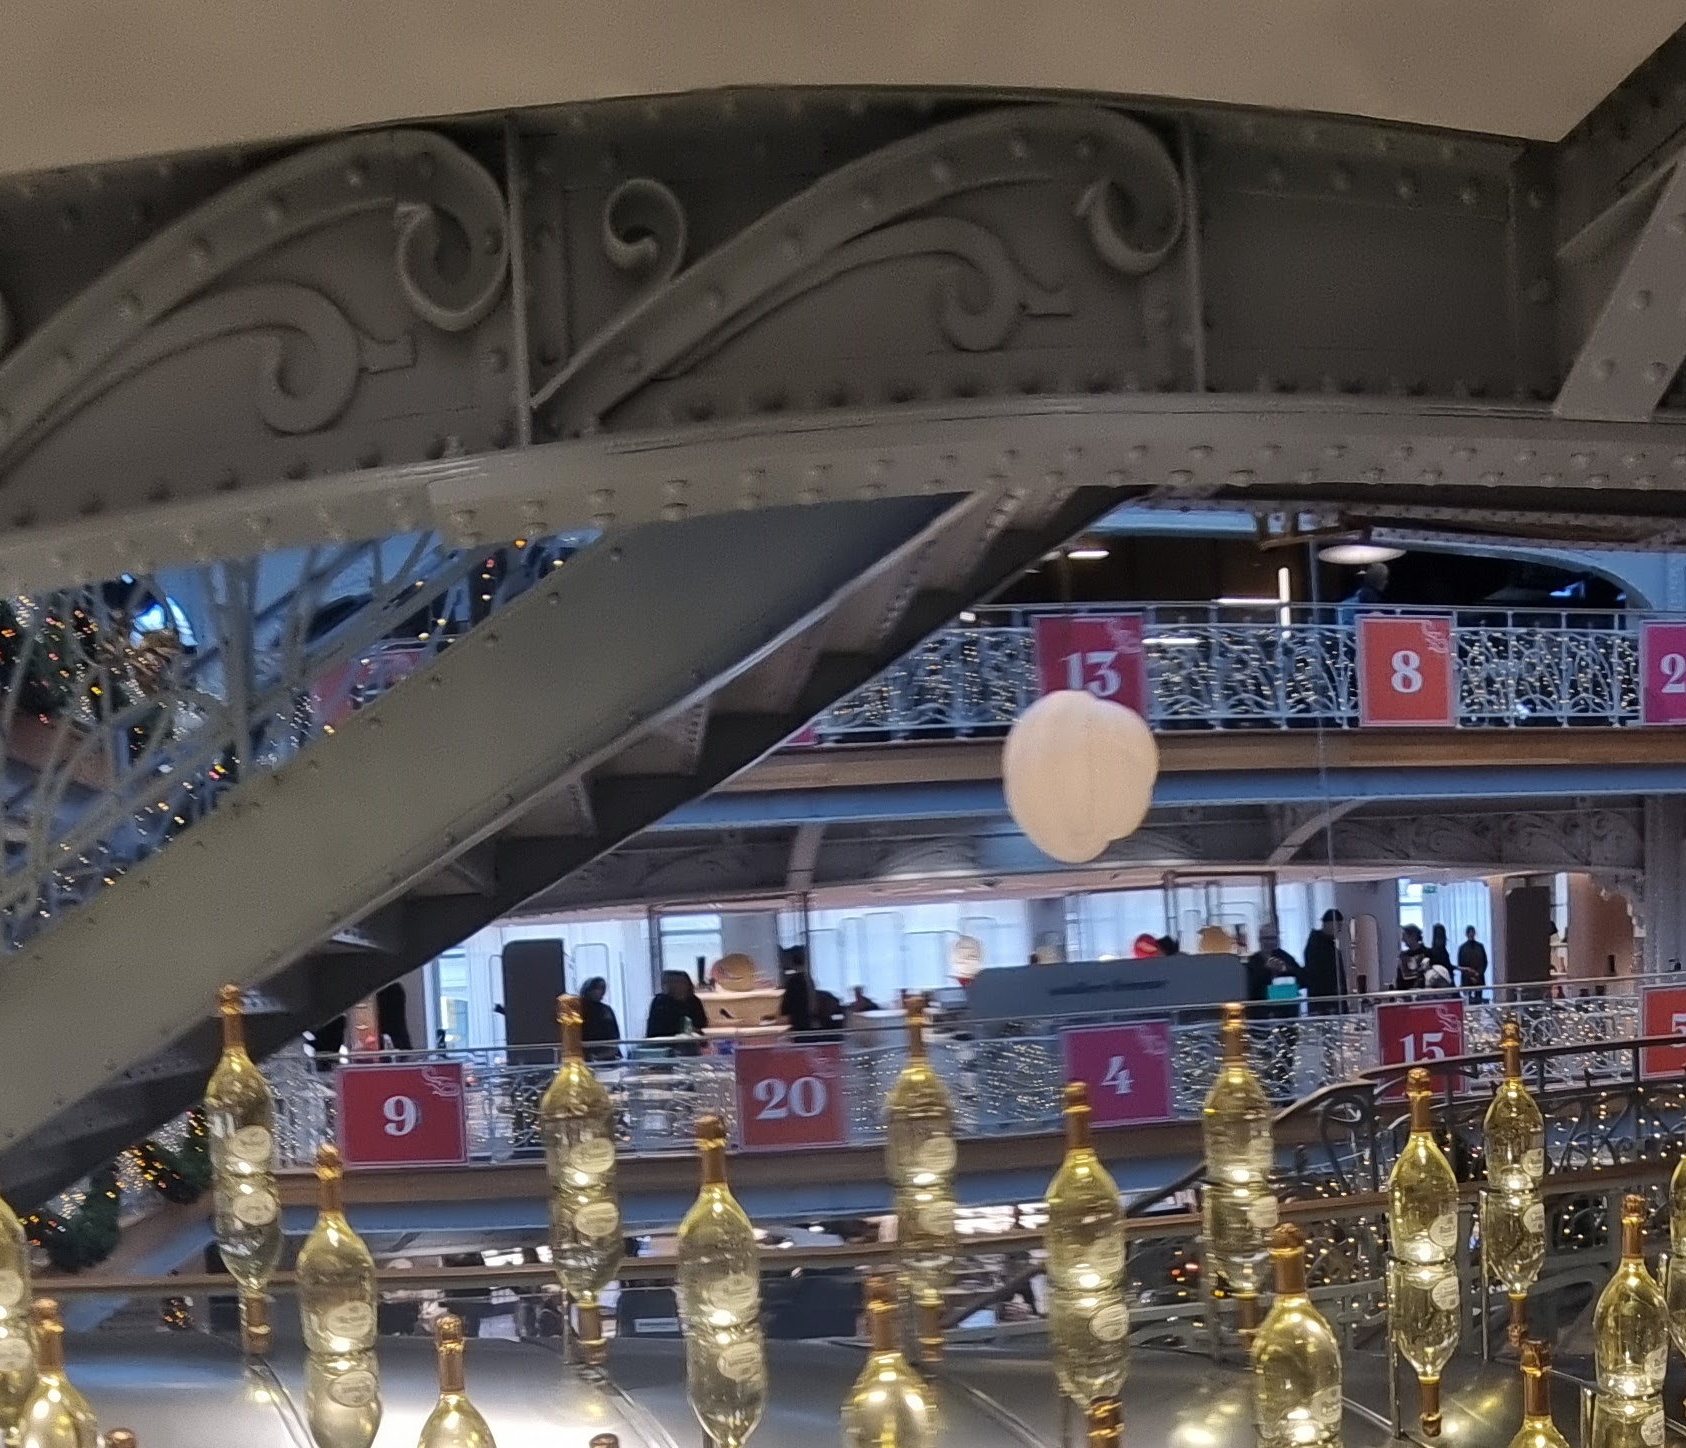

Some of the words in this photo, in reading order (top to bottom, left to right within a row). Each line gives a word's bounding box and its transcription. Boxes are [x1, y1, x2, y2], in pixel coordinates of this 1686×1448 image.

[1060, 650, 1122, 697] 13
[1391, 650, 1422, 693] 8
[1399, 1031, 1445, 1064] 15
[1101, 1055, 1134, 1095] 4
[383, 1095, 416, 1136] 9
[753, 1076, 827, 1120] 20
